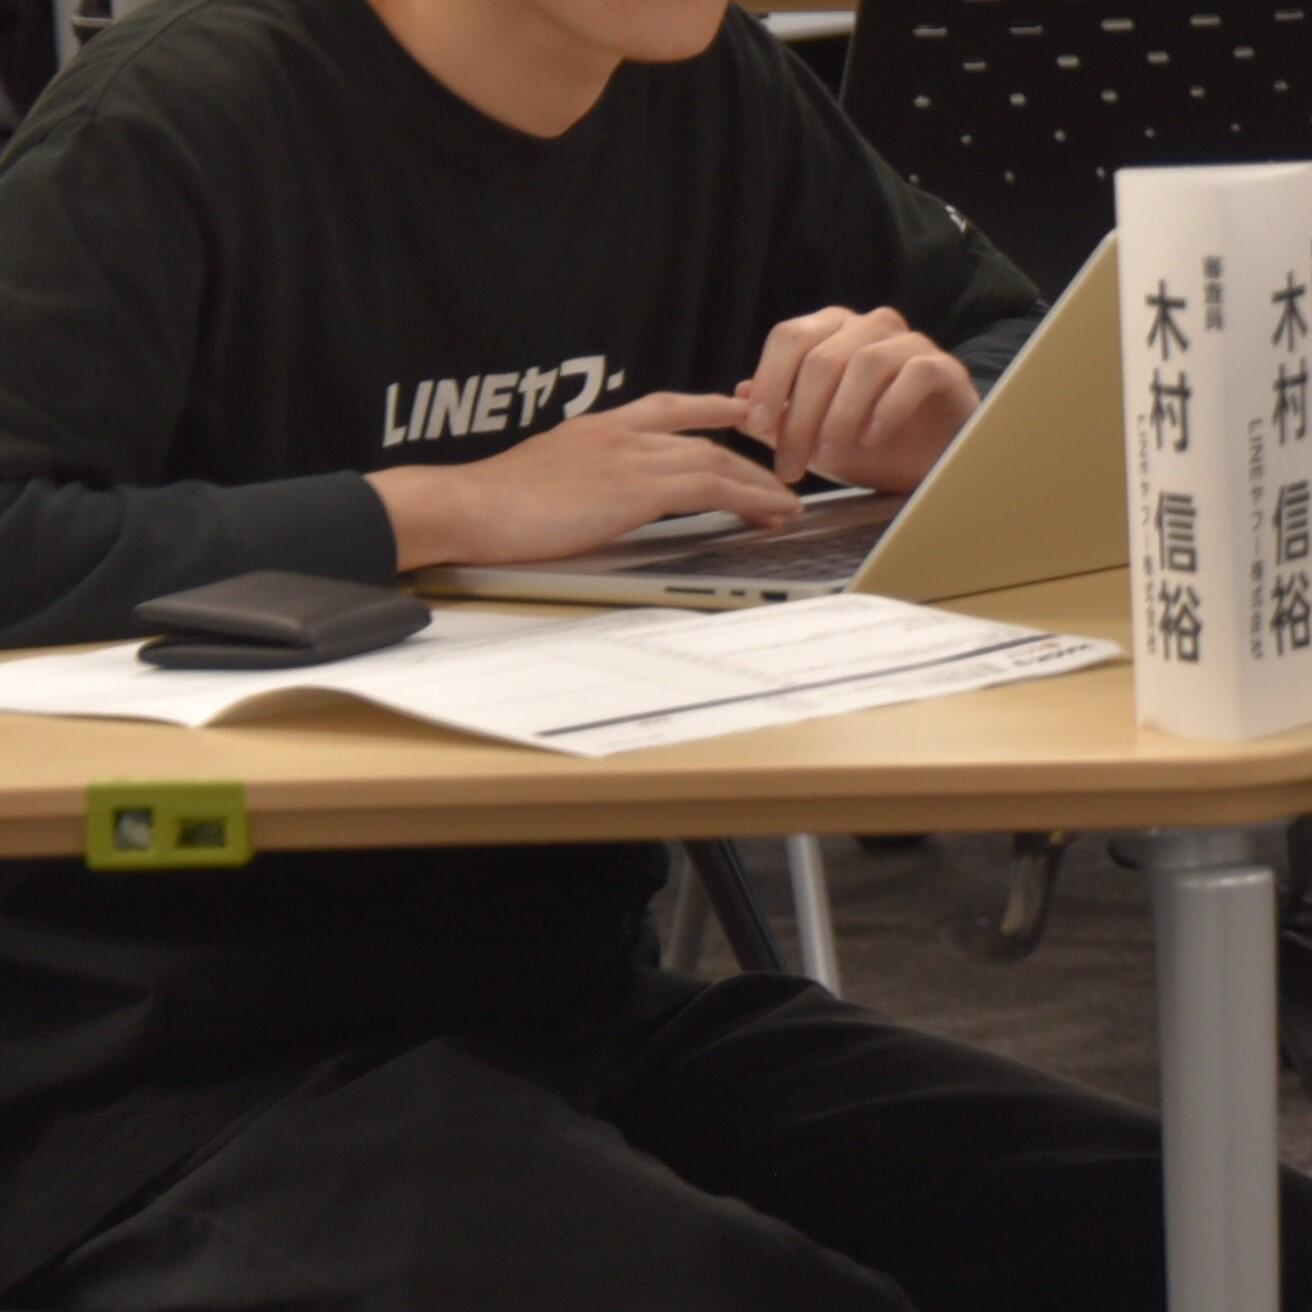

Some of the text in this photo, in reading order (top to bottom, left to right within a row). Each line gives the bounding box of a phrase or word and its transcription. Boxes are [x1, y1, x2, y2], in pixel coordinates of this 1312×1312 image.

[1145, 279, 1203, 663] 木村 信裕
[1269, 271, 1312, 656] 木村 信裕
